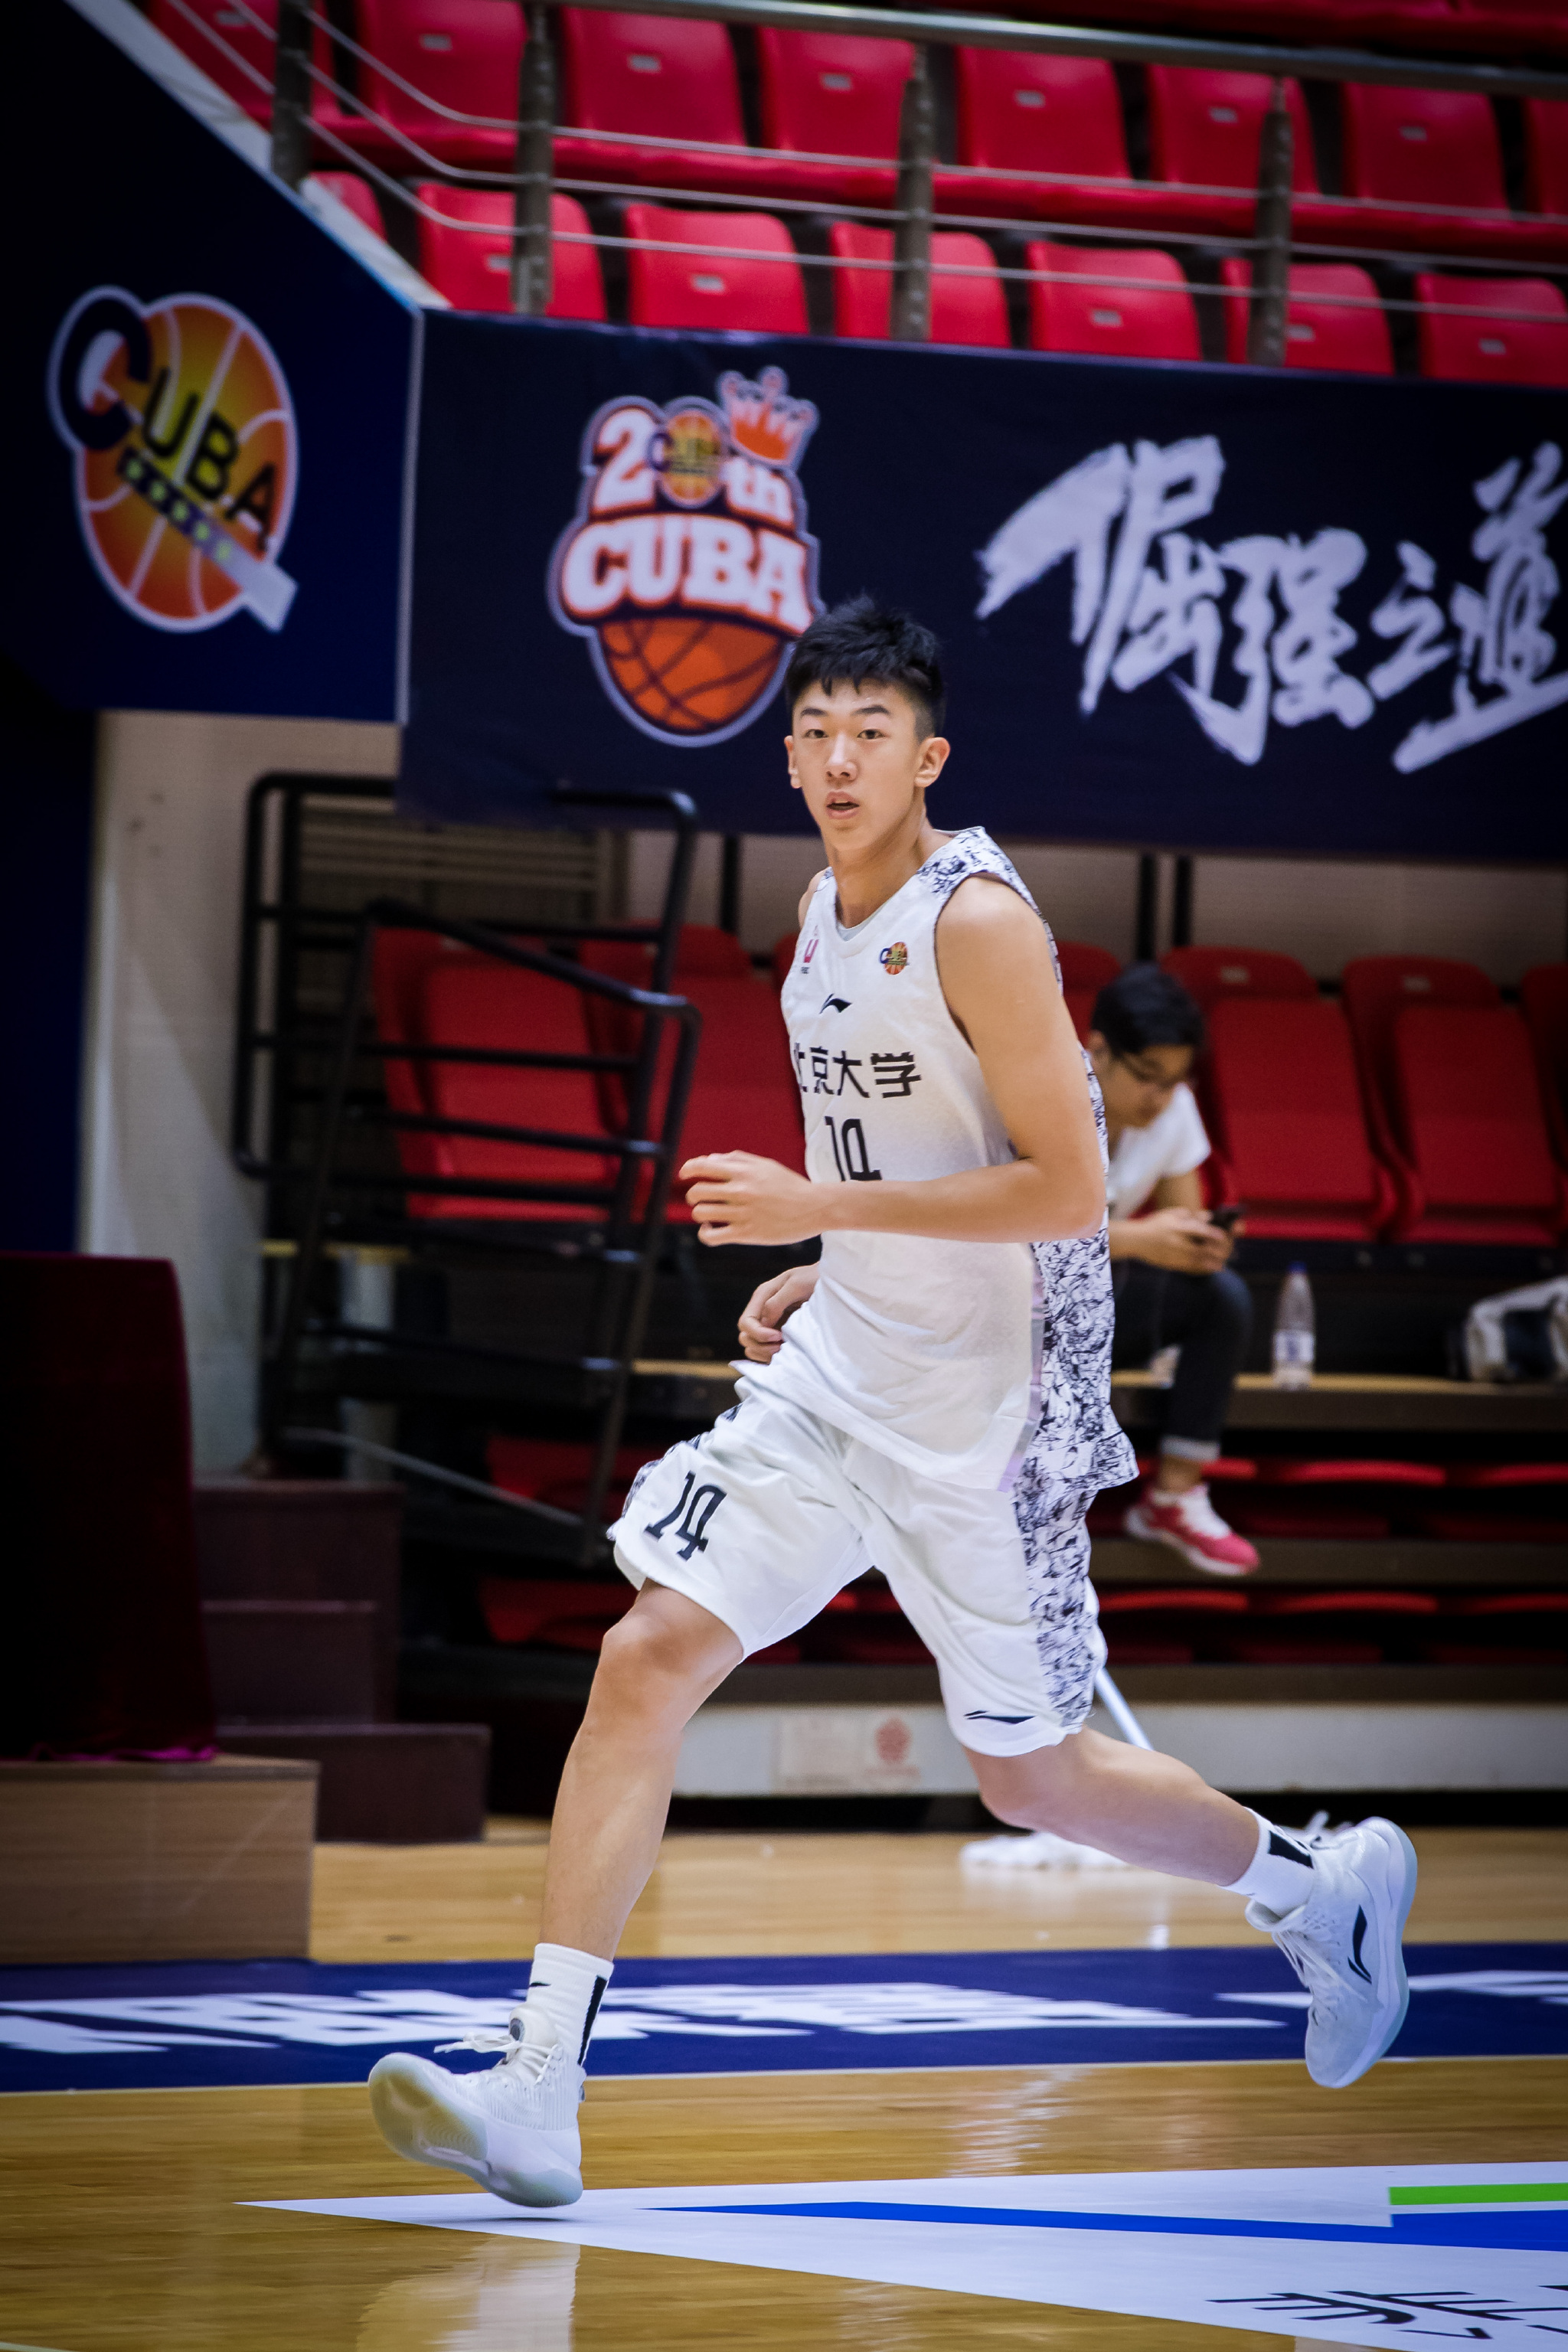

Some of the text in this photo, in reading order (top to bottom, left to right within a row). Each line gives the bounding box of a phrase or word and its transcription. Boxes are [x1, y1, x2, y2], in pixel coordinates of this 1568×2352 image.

[52, 295, 277, 553] CUBA
[561, 511, 815, 635] CUBA
[644, 1470, 727, 1561] 14
